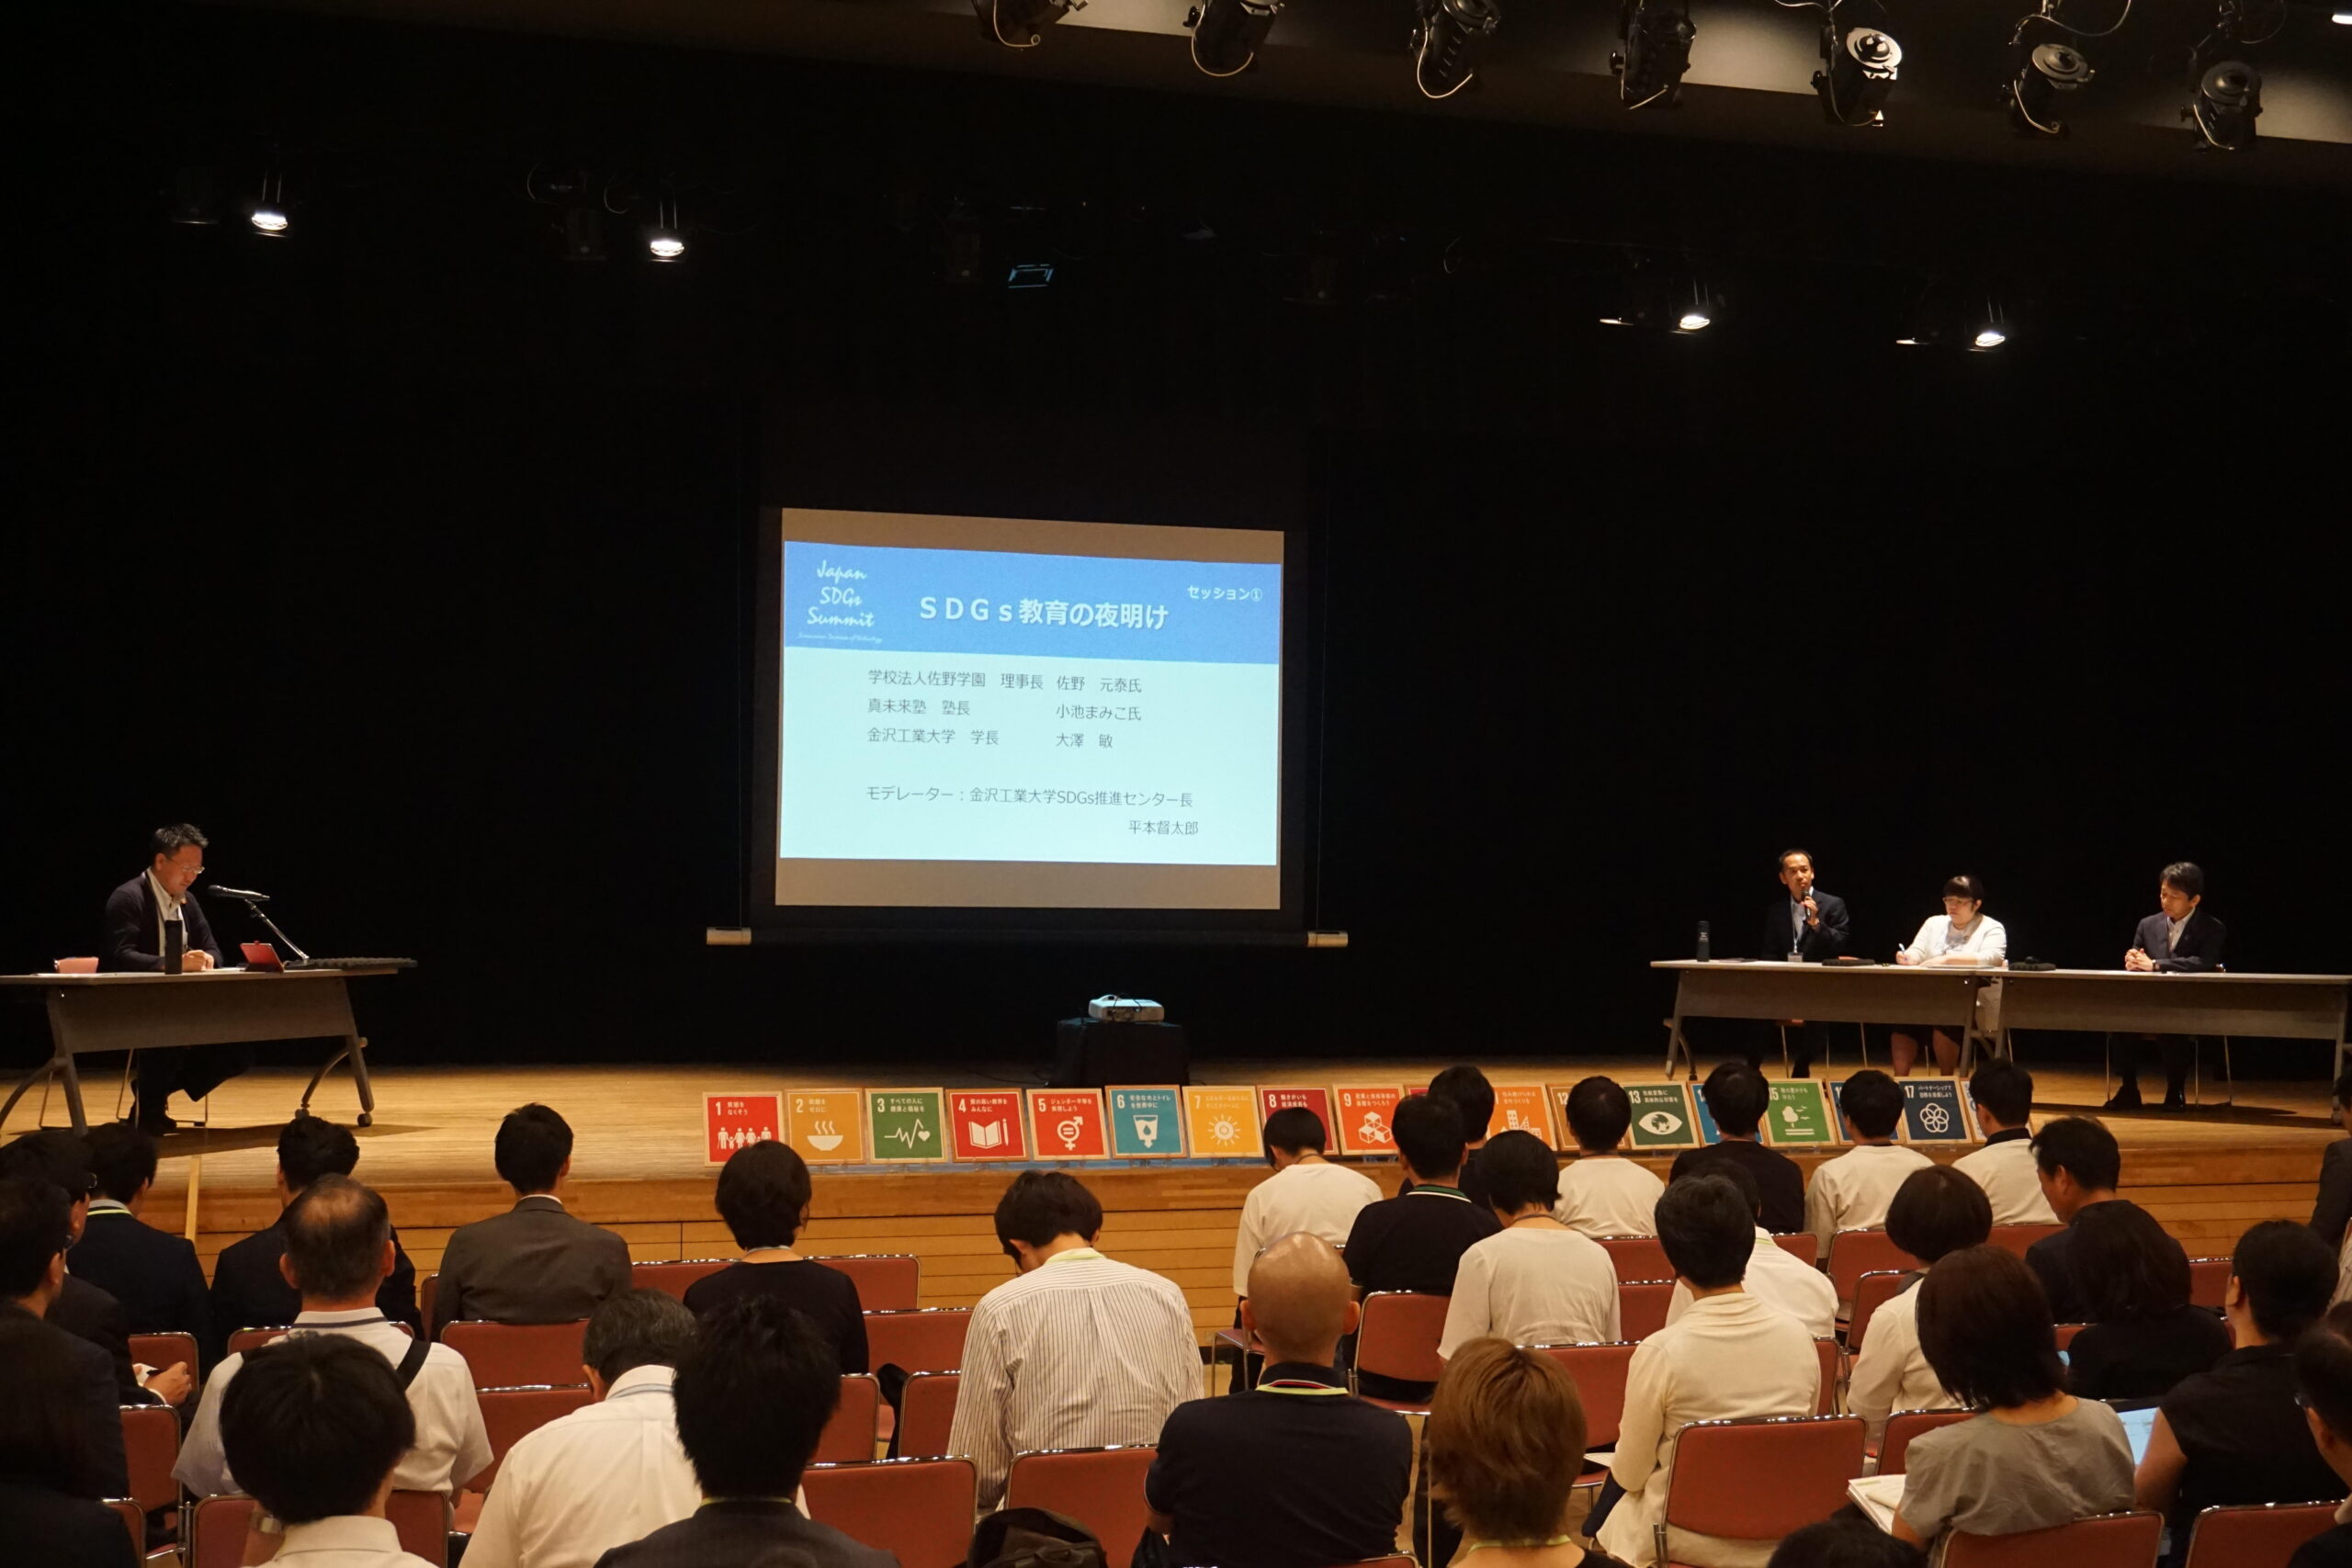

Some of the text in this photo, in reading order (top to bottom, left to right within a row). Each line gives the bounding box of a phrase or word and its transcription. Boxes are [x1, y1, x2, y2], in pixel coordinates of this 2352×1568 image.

[817, 559, 867, 584] Japan
[820, 586, 862, 607] SDGs
[1187, 585, 1263, 603] セッション①
[807, 606, 875, 627] Summit
[867, 670, 1142, 694] 学校法人佐野学園 理事長 佐野 元泰氏
[867, 698, 1142, 721] 真未来塾 塾長 小池まみこ氏
[867, 728, 956, 744] 金沢工業大学
[970, 729, 1000, 745] 学長
[1056, 732, 1084, 748] 大澤
[1128, 819, 1199, 836] 平本督太郎
[1343, 1092, 1352, 1107] 9
[1628, 1089, 1642, 1104] 13
[1904, 1085, 1915, 1099] 17
[715, 1101, 721, 1116] 1
[796, 1098, 804, 1113] 2
[876, 1098, 886, 1112] 3
[958, 1098, 967, 1113] 4
[1037, 1098, 1046, 1112] 5
[1116, 1094, 1125, 1109] 6
[1193, 1095, 1201, 1110] 7
[1268, 1094, 1277, 1108] 8
